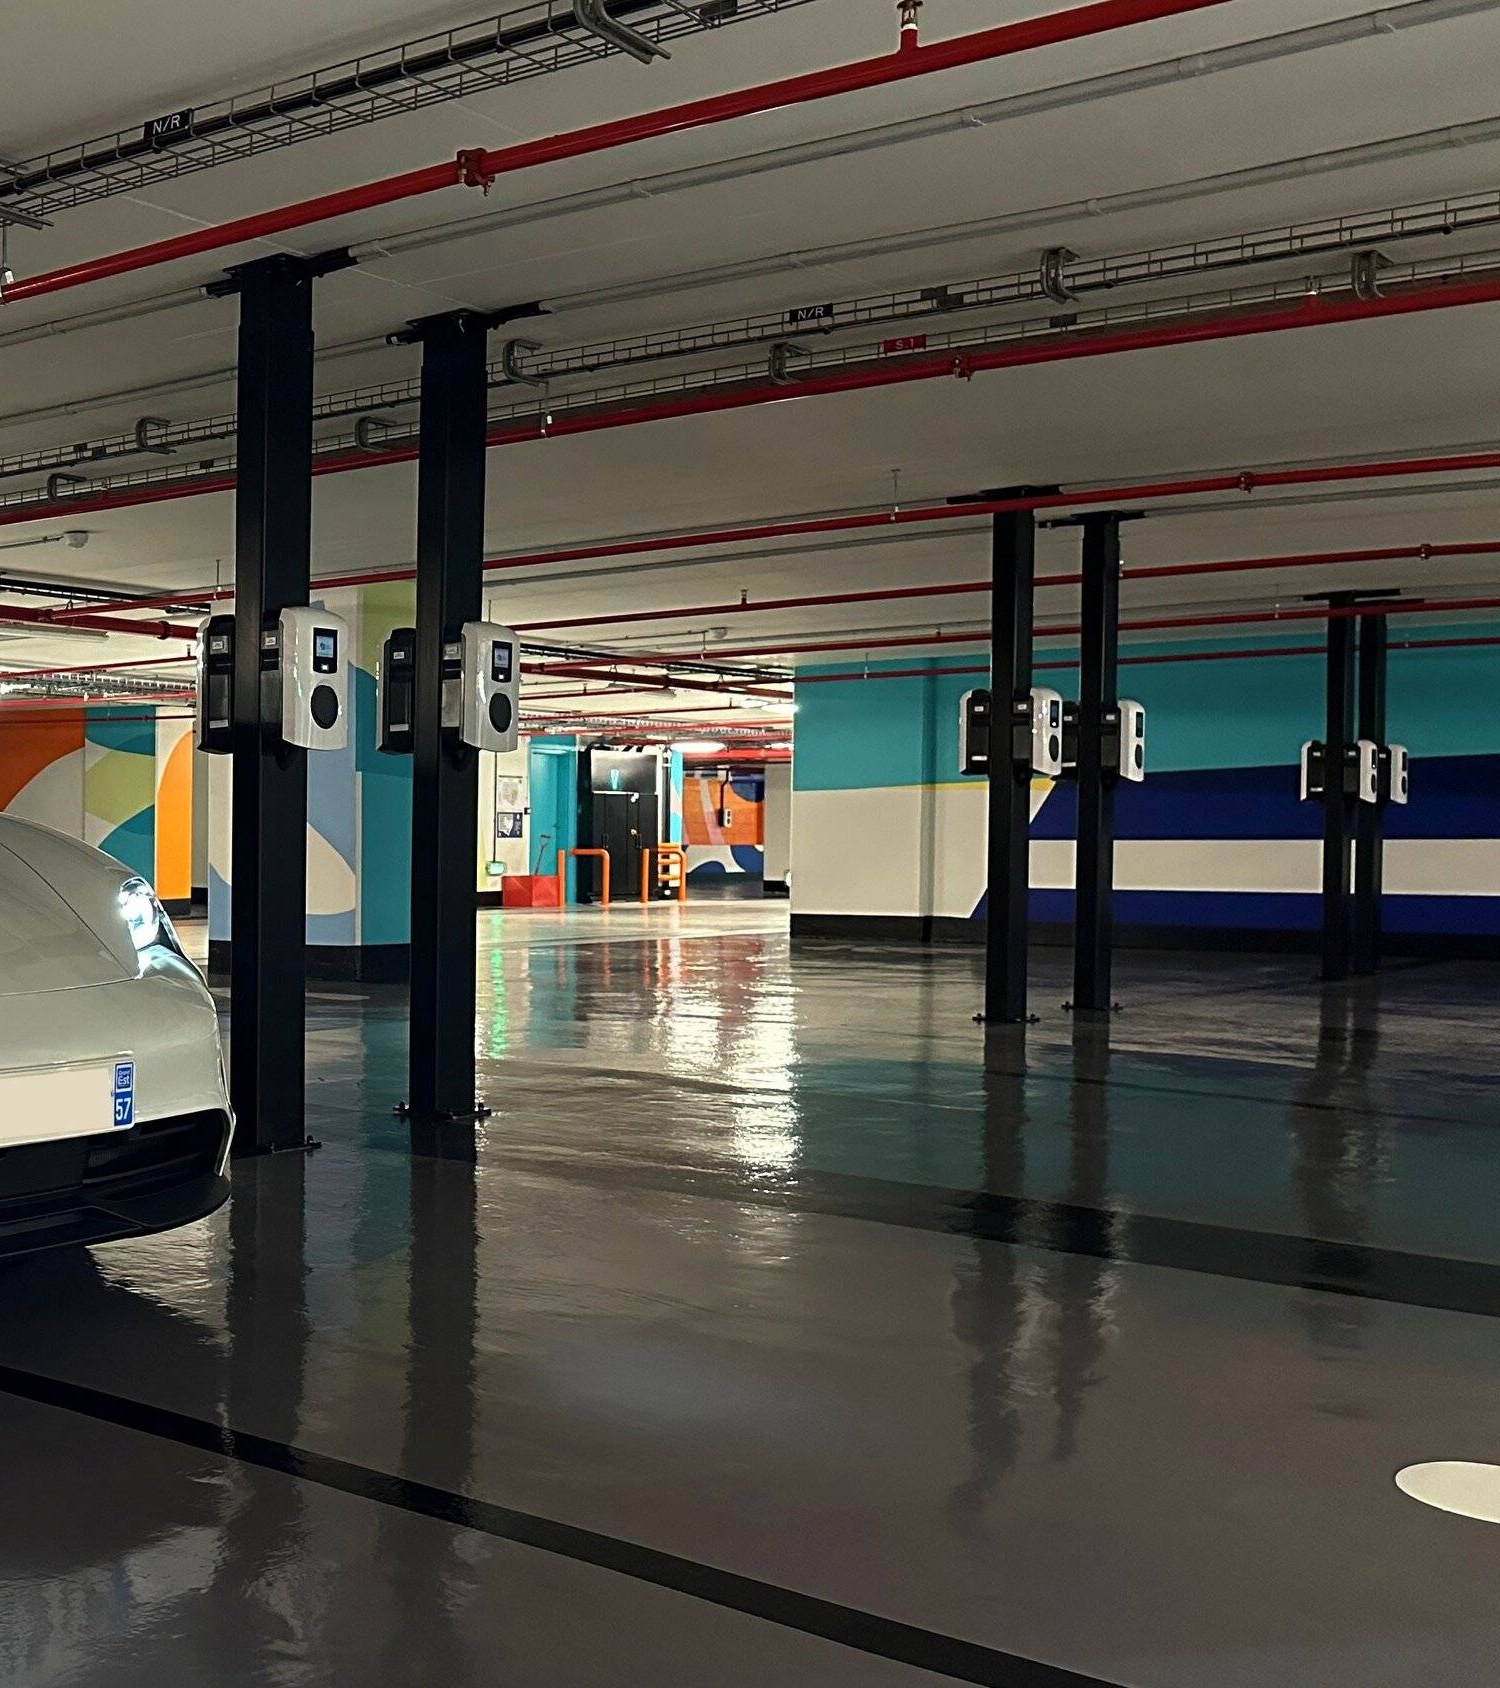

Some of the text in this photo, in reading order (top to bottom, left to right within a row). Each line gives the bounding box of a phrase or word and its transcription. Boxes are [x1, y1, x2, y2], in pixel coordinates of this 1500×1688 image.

[152, 114, 181, 134] N/R
[797, 306, 824, 320] N/R
[895, 338, 914, 350] S.1
[118, 1075, 130, 1085] Est
[115, 1097, 131, 1121] 57
